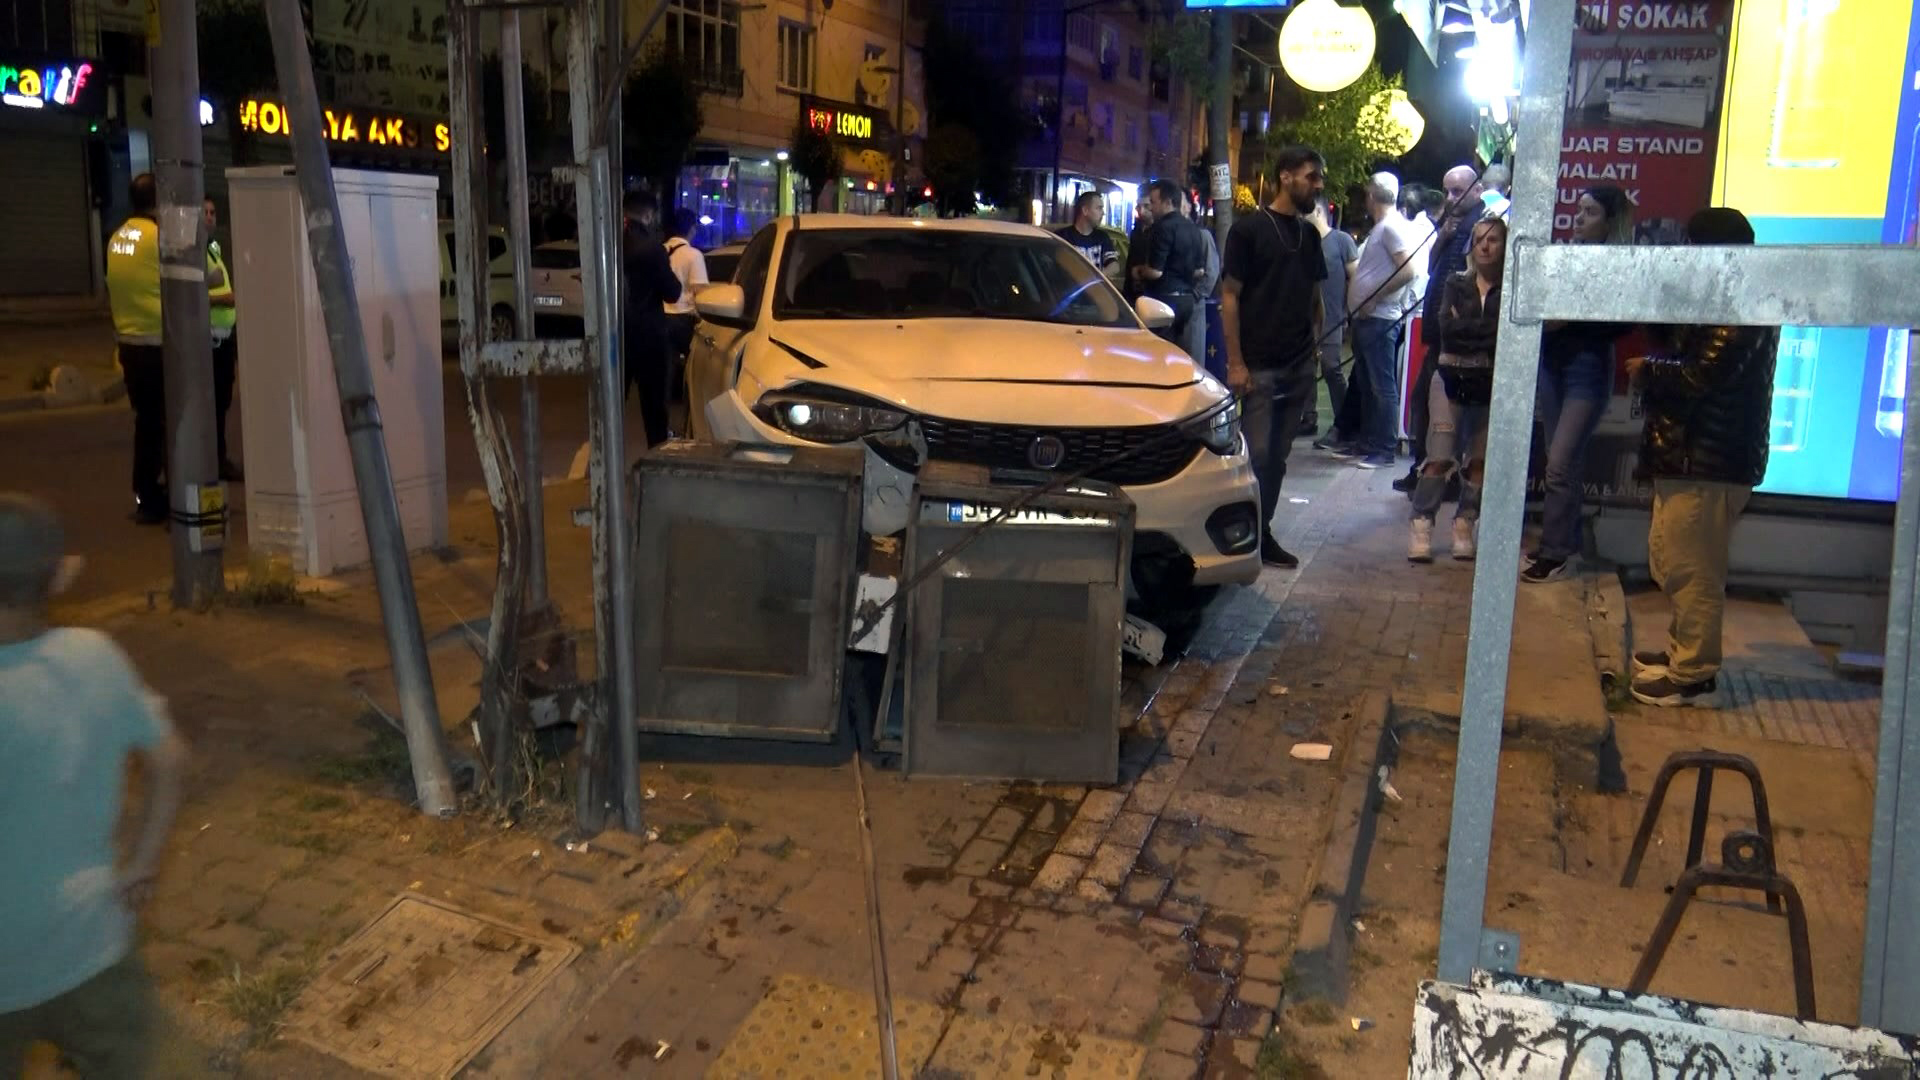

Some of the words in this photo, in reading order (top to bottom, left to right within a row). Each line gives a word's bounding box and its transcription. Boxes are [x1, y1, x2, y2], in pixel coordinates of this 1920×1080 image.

[1617, 4, 1709, 29] SOKAK
[1661, 47, 1717, 64] AHŞAP
[837, 111, 871, 138] LEMON
[1617, 137, 1704, 154] STAND
